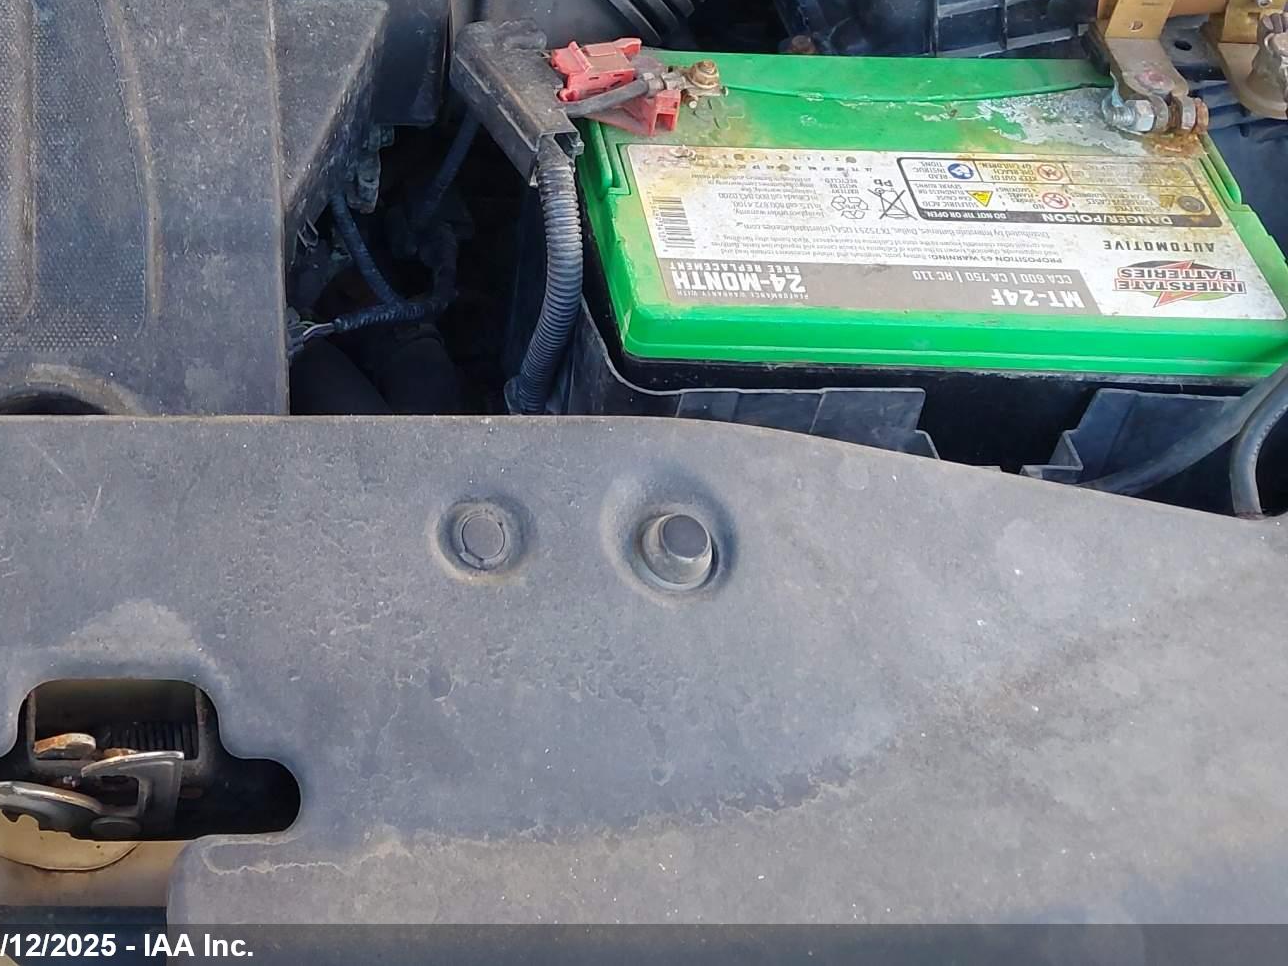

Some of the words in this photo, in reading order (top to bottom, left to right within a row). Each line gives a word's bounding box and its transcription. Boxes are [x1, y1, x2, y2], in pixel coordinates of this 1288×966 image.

[873, 179, 892, 187] Pb
[1041, 213, 1173, 225] DANGER/POISON
[891, 227, 918, 235] Dallas,
[1102, 240, 1215, 253] AUTOMOTIVE
[928, 254, 979, 262] WARNING:
[669, 261, 762, 273] REPLACEMENT
[767, 264, 800, 274] FREE
[912, 270, 934, 280] 110
[936, 271, 954, 281] RC
[964, 271, 989, 282] 750
[991, 272, 1008, 283] CA
[1019, 273, 1045, 284] 600
[1047, 274, 1073, 285] CCA
[1119, 268, 1233, 280] BATTERIES
[671, 270, 806, 293] 24-MONTH
[1117, 280, 1244, 292] INTERSTATE
[700, 290, 745, 298] WARRANTY
[750, 291, 809, 300] PERFORMANCE
[990, 288, 1085, 308] MT-24F
